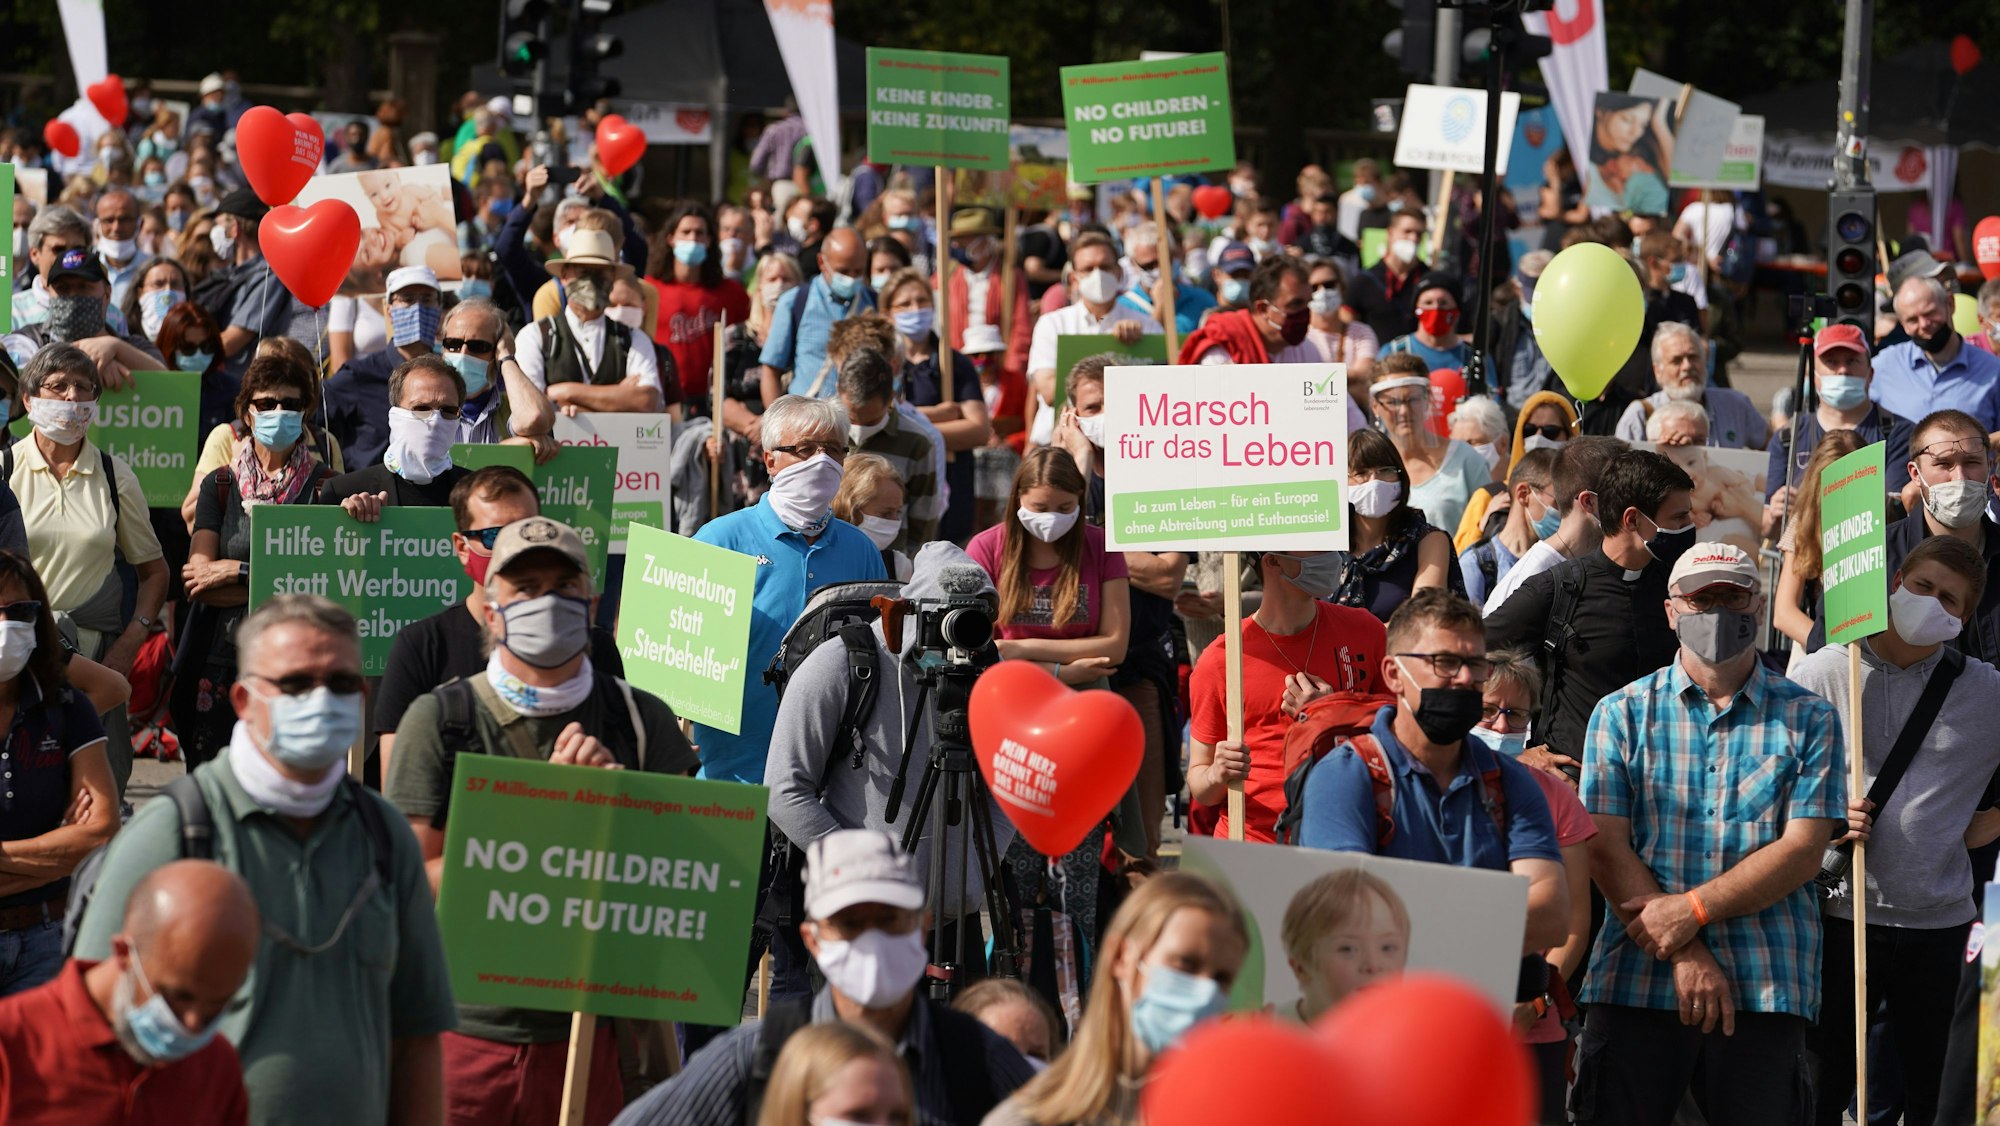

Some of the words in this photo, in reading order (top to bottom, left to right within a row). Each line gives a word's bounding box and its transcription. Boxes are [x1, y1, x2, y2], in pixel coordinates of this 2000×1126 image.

[876, 87, 927, 106] KEINE
[931, 91, 993, 109] KINDER
[1075, 104, 1107, 122] NO
[1112, 95, 1208, 119] CHILDREN
[871, 110, 921, 128] KEINE
[925, 113, 1008, 134] ZUKUNFT!
[1091, 127, 1124, 144] NO
[1128, 119, 1207, 141] FUTURE!
[94, 394, 184, 429] usion
[1139, 391, 1269, 426] Marsch
[1119, 434, 1154, 459] für
[1164, 434, 1212, 459] das
[1222, 433, 1334, 467] Leben
[612, 509, 647, 521] Europa
[1133, 501, 1147, 514] Ja
[1151, 502, 1177, 513] zum
[1181, 497, 1216, 511] Leben
[1231, 493, 1248, 508] für
[1252, 493, 1271, 506] ein
[1275, 491, 1318, 508] Europa
[1125, 521, 1155, 535] ohne
[1159, 517, 1227, 533] Abtreibung
[1231, 515, 1254, 528] und
[1258, 510, 1330, 527] Euthanasie!
[1840, 510, 1873, 545] KINDER
[265, 526, 325, 556] Hilfe
[333, 526, 371, 556] für
[380, 529, 457, 557] Fraue
[1839, 544, 1884, 583] ZUKUNFT!
[273, 572, 329, 597] statt
[337, 568, 457, 606] Werbung
[642, 553, 736, 617] Zuwendung
[669, 605, 703, 636] statt
[992, 752, 1033, 784] BRENNT
[1000, 738, 1028, 763] MEIN
[1028, 751, 1057, 778] HERZ
[994, 769, 1012, 791] DAS
[465, 777, 488, 792] 57
[492, 780, 569, 801] Millionen
[573, 789, 683, 816] Abtreibungen
[688, 802, 756, 822] weltweit
[464, 837, 529, 873] NO
[540, 846, 721, 893] CHILDREN
[487, 890, 550, 925] NO
[562, 897, 707, 941] FUTURE!
[477, 972, 698, 1003] www.marsch-fuer-das-leben.de
